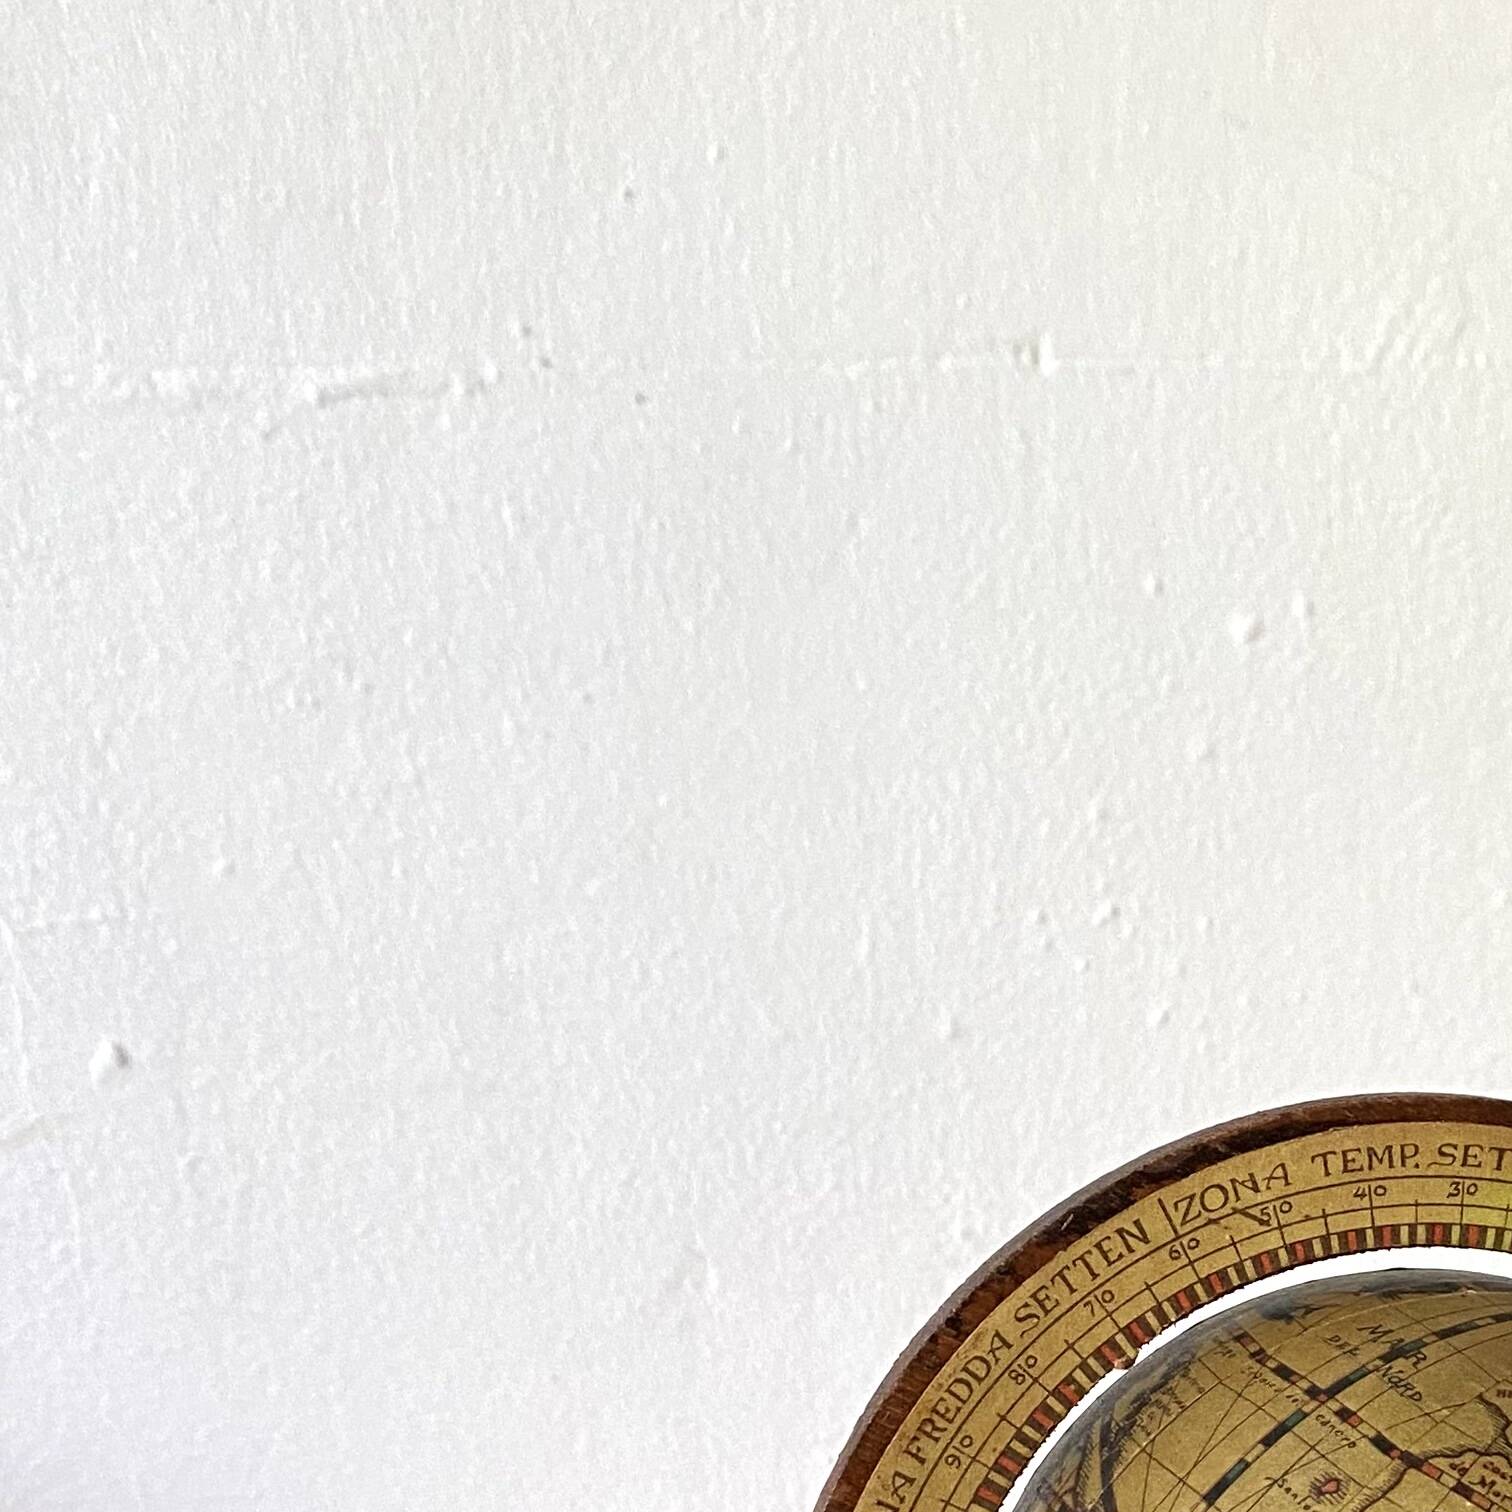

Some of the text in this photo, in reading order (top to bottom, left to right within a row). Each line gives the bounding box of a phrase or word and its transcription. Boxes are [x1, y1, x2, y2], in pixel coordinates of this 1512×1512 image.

[1173, 1161, 1293, 1228] ZONA
[904, 1329, 1014, 1466] FREDDA
[1013, 1218, 1153, 1338] SETTEN
